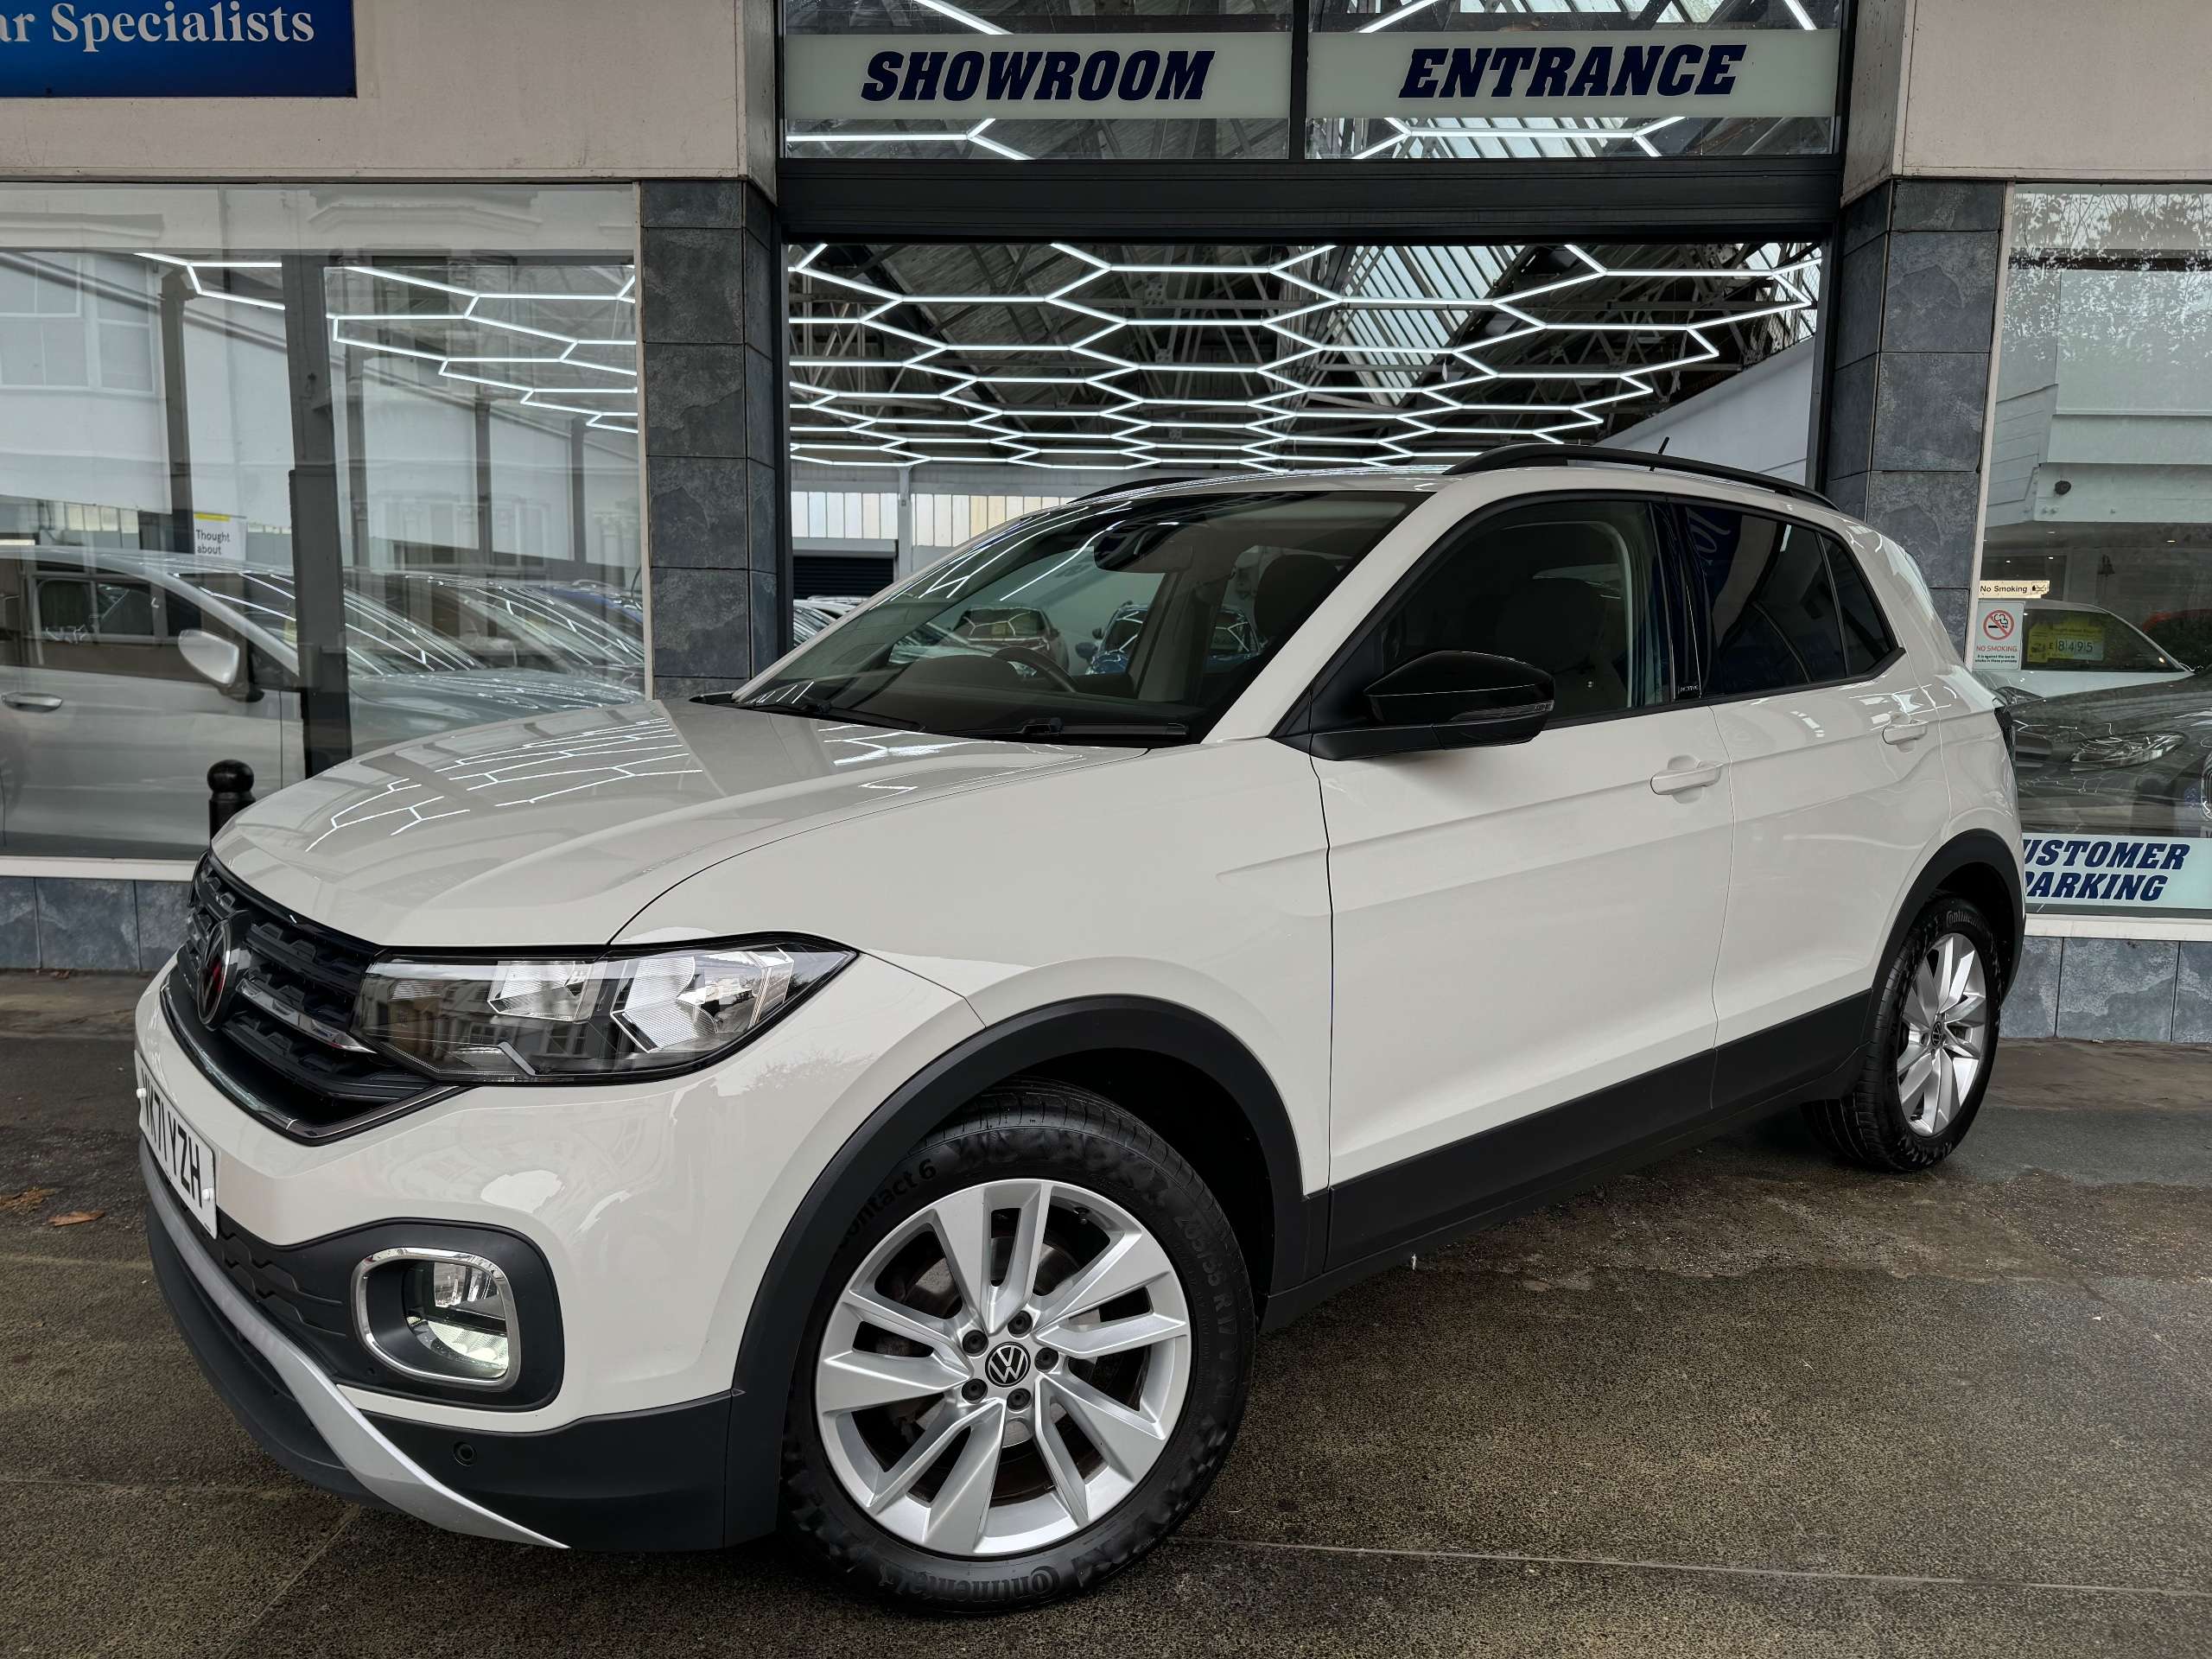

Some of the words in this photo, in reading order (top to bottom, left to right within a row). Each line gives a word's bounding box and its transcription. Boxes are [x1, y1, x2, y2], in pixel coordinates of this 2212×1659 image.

[52, 1, 315, 53] Specialists
[861, 49, 1216, 103] SHOWROOM
[1398, 43, 1746, 99] ENTRANCE
[195, 529, 231, 543] Thought
[197, 543, 222, 556] about
[1993, 585, 2028, 594] Smoking
[2023, 839, 2190, 870] USTOMER
[168, 1110, 203, 1210] YZH
